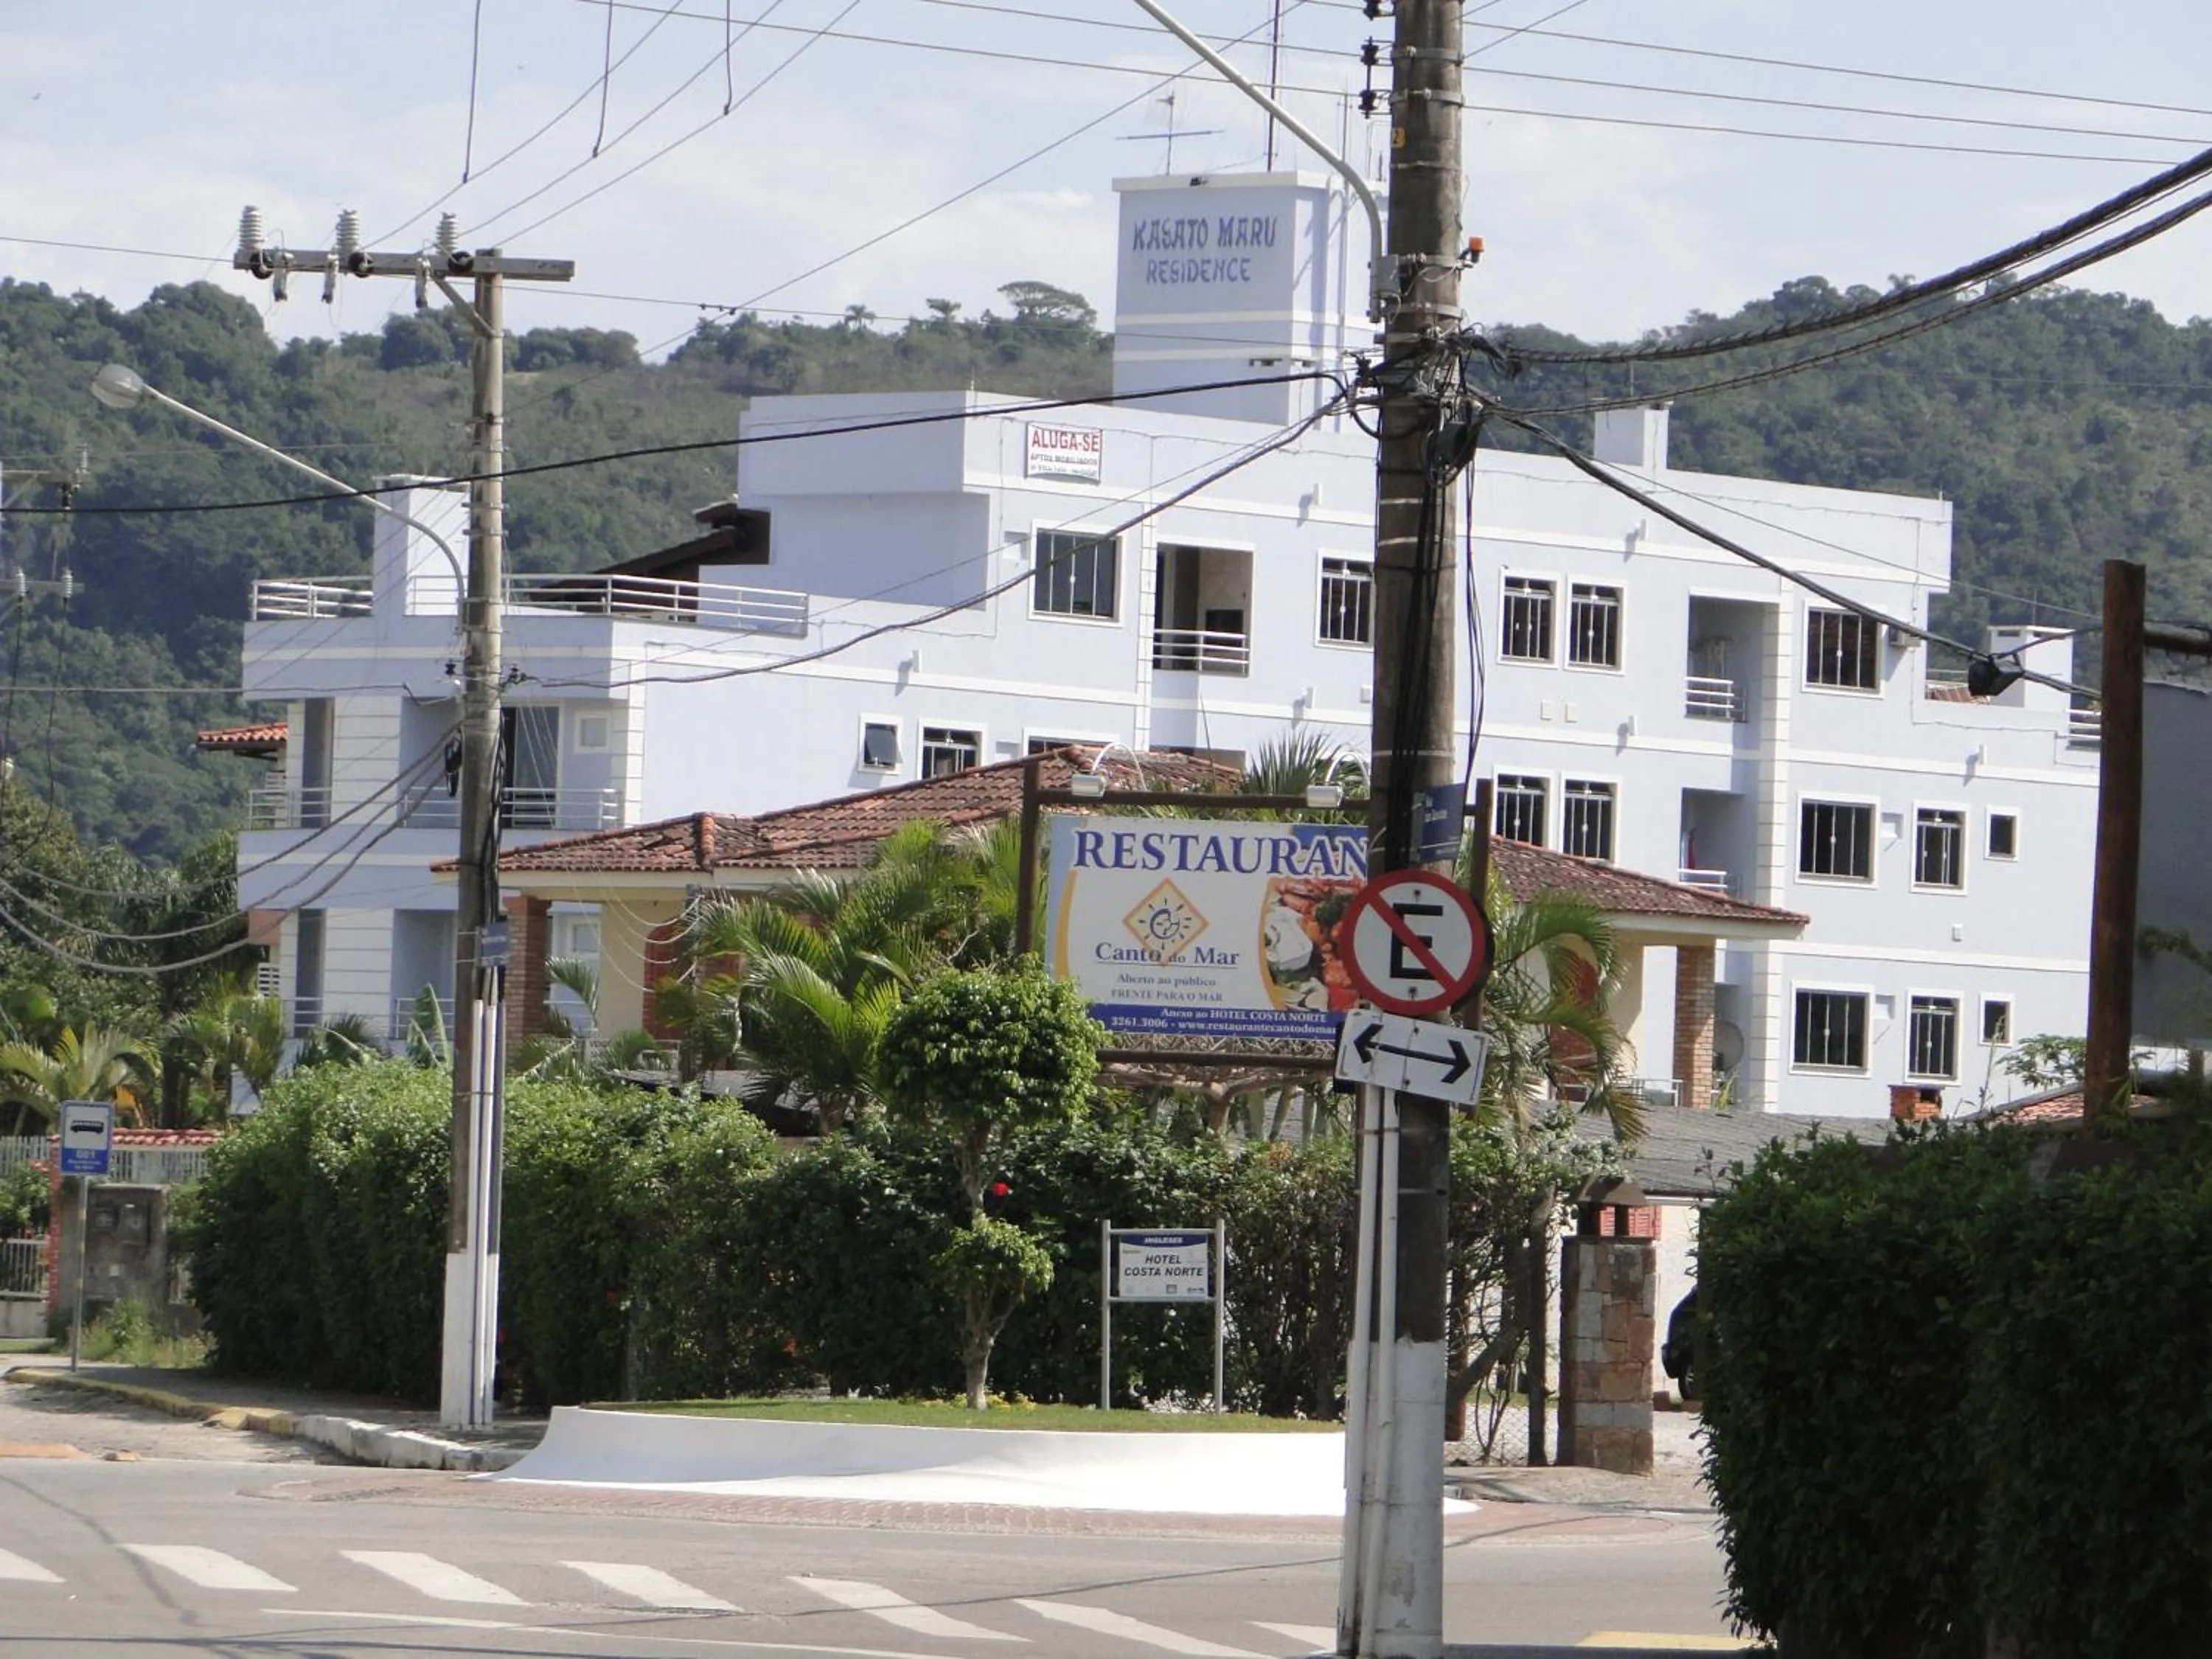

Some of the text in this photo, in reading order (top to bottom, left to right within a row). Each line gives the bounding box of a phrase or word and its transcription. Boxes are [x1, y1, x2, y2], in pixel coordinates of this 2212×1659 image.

[1133, 215, 1278, 251] KASATO MARU
[1146, 257, 1251, 284] RESIDENCE
[1032, 430, 1099, 452] ALUGA-SE
[1095, 942, 1240, 965] Canto do Mar
[1116, 973, 1155, 984] Aberto
[1111, 989, 1152, 999] FRENTE
[1156, 990, 1185, 1001] PARA
[1198, 992, 1222, 1002] MAR
[1161, 1008, 1326, 1023] Anexo ao HOTEL COSTA NORTE
[1145, 1254, 1182, 1265] HOTEL
[1124, 1267, 1204, 1276] COSTA NORTE
